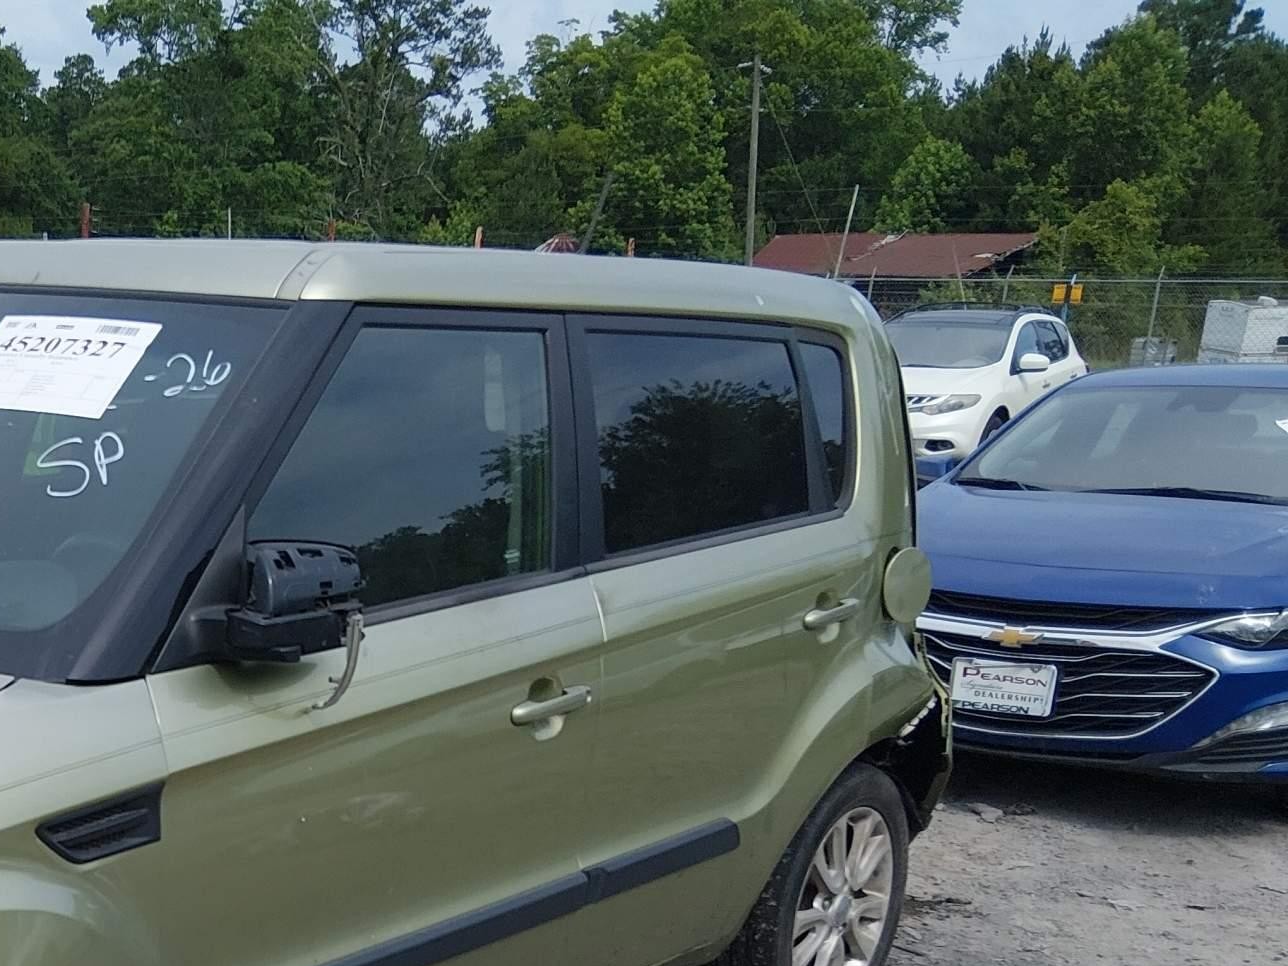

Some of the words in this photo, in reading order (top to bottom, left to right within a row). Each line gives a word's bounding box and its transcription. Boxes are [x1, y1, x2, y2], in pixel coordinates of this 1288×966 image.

[0, 335, 128, 359] 45207327
[36, 431, 125, 497] SP
[962, 666, 1047, 687] PEARSON
[962, 700, 1030, 714] PEARSON
